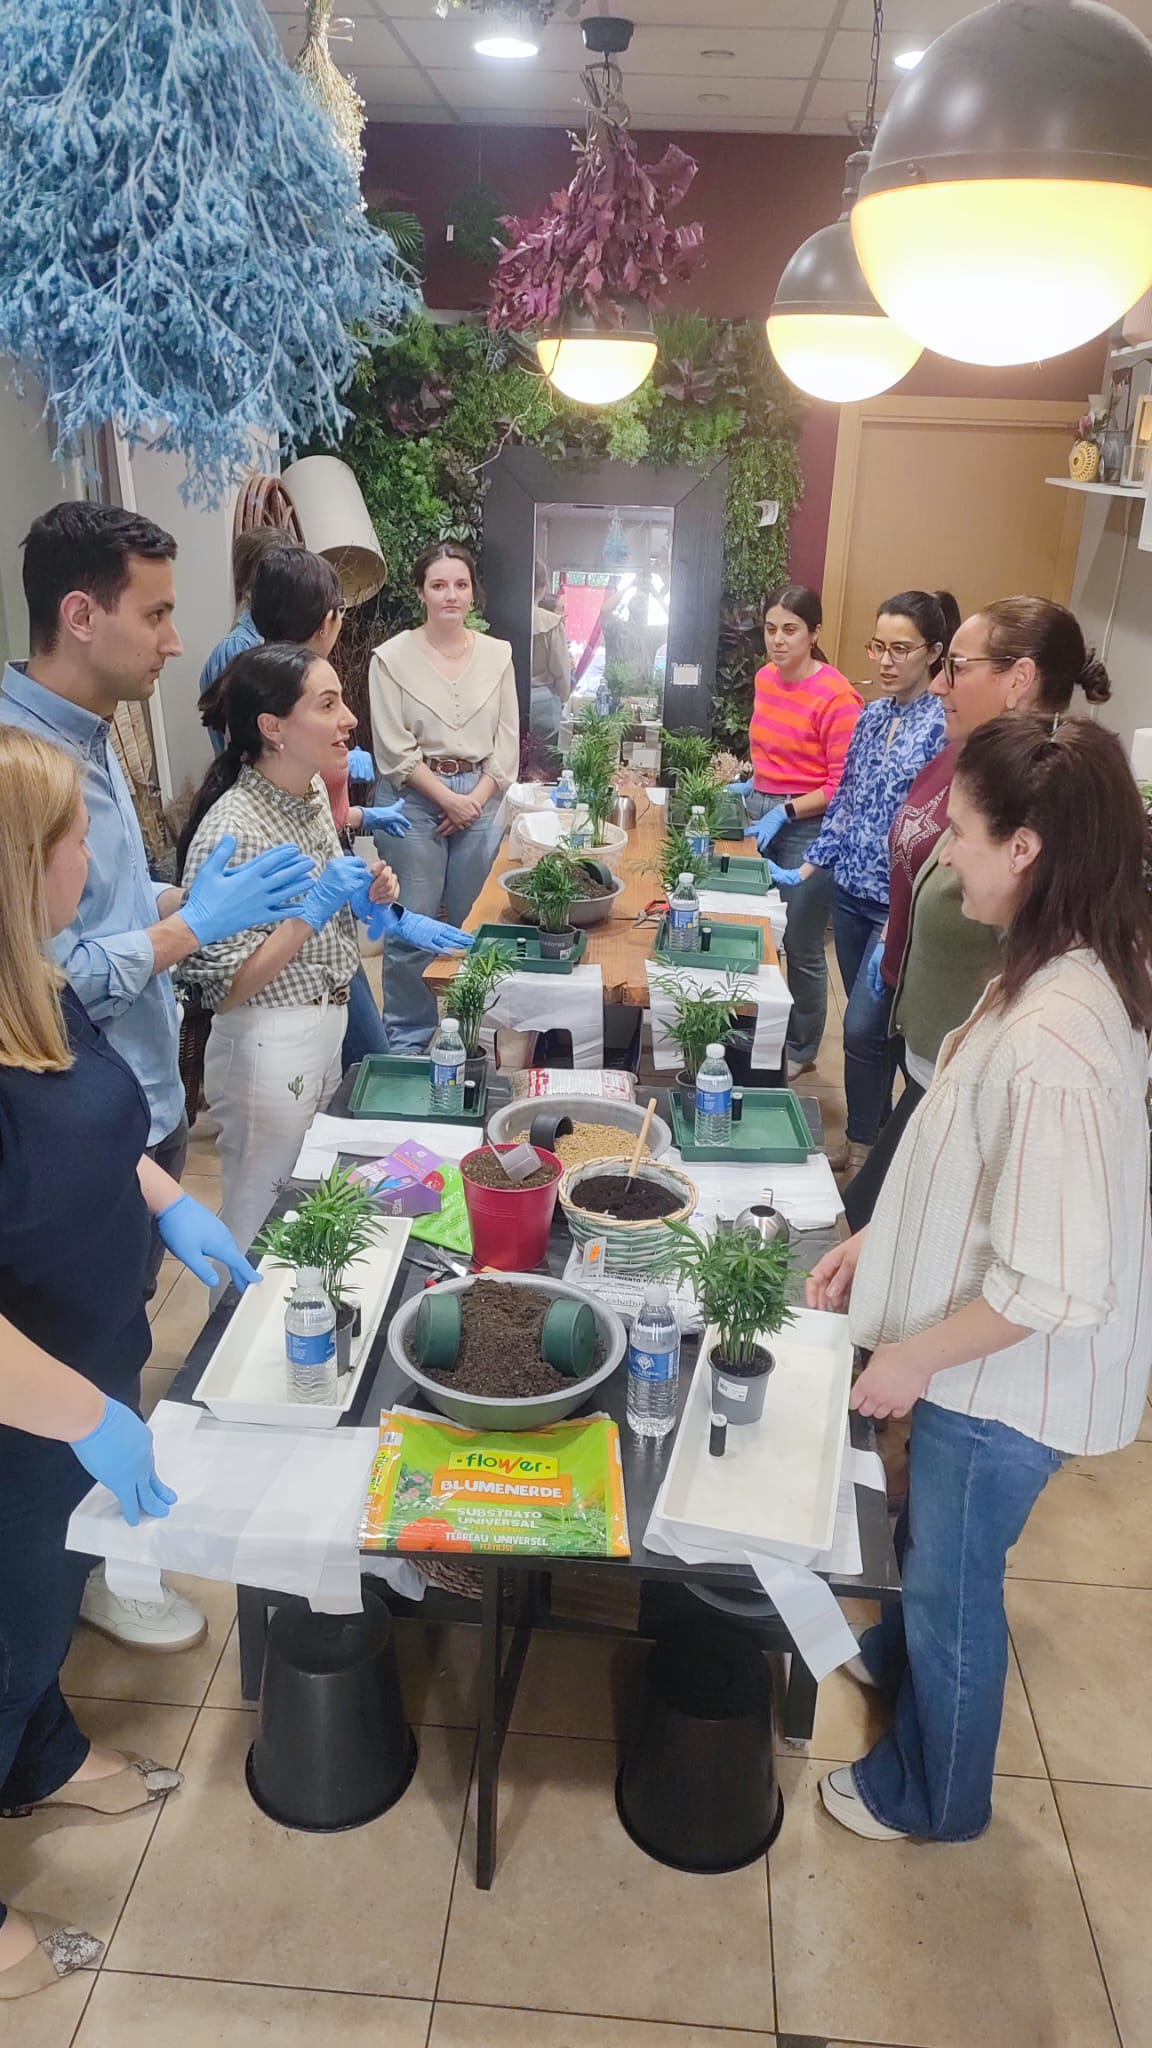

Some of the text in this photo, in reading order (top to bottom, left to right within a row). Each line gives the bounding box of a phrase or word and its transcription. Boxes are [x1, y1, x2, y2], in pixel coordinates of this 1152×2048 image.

[465, 1453, 542, 1474] flower
[440, 1479, 563, 1499] BLUMENERDE
[457, 1507, 543, 1520] SUBSTRATO
[458, 1517, 539, 1529] UNIVERSAL
[445, 1531, 548, 1547] TERREAU UNIVERSEL
